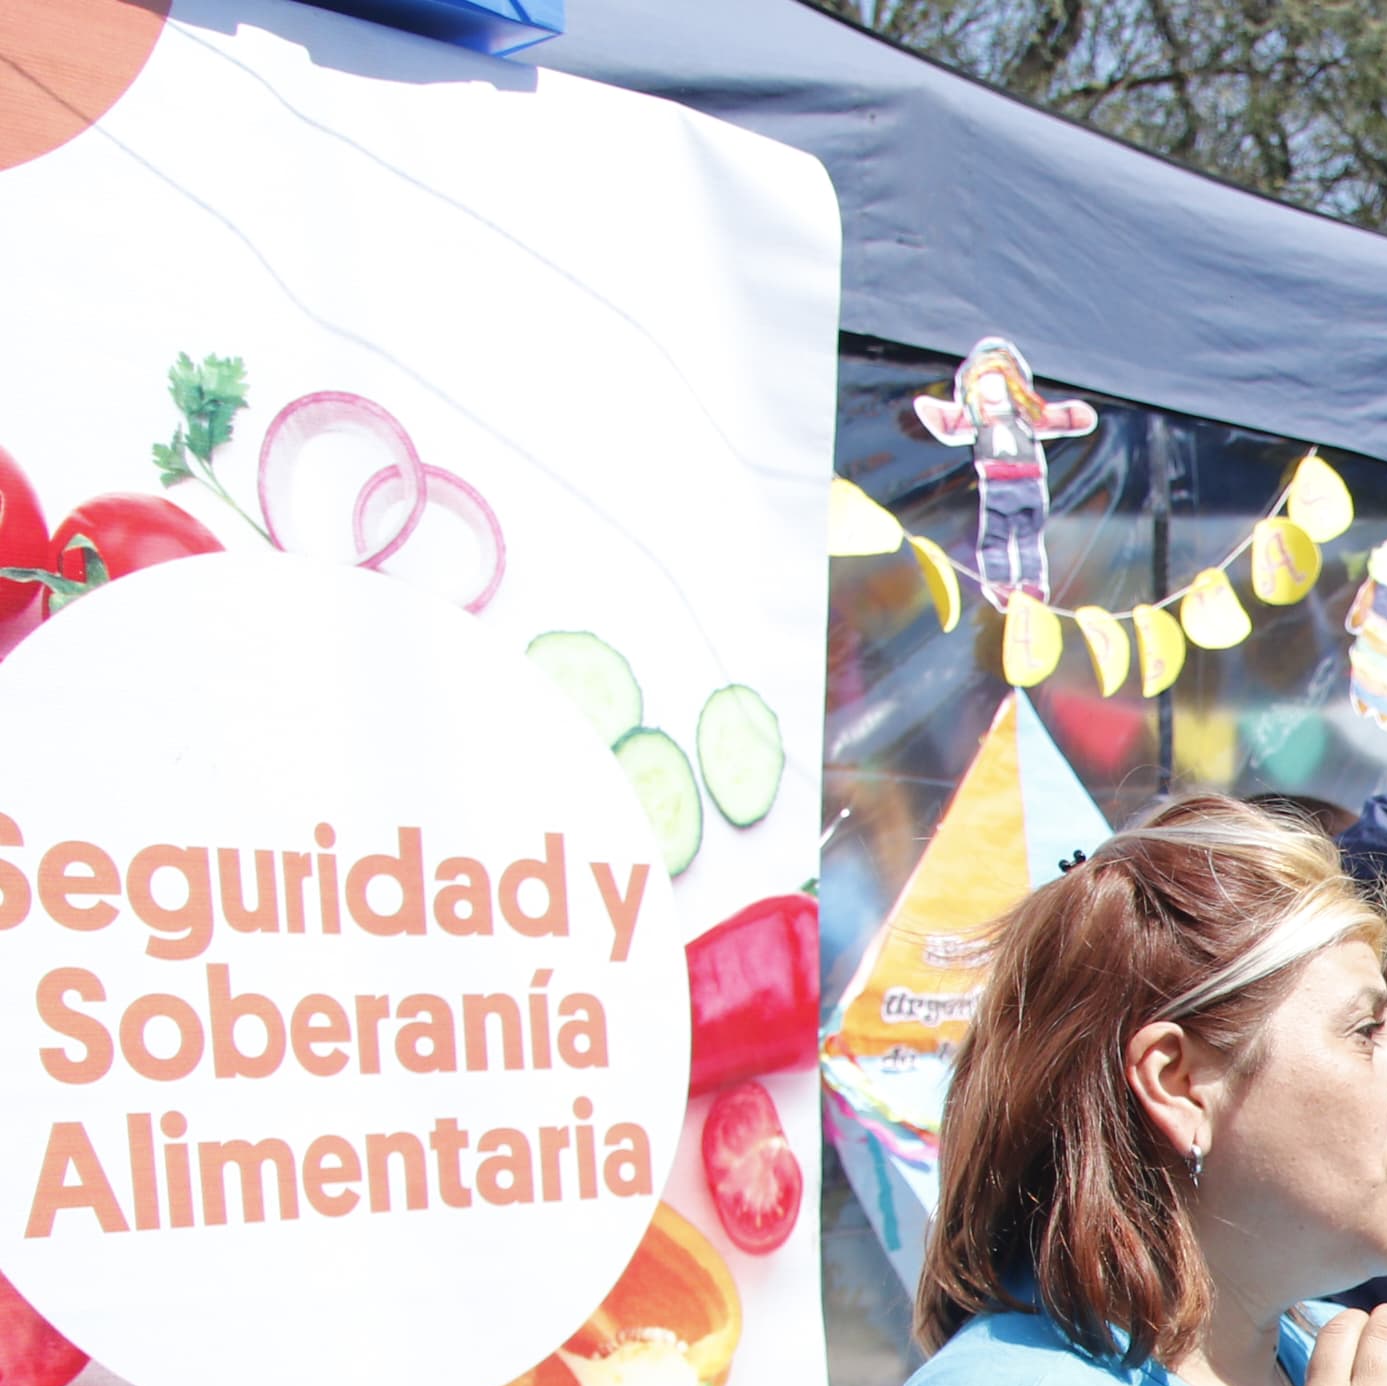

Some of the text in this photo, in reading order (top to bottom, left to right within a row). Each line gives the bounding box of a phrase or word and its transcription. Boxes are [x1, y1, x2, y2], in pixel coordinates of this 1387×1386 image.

[0, 811, 651, 963] Seguridad y
[34, 962, 609, 1084] Soberanía
[23, 1096, 654, 1239] Alimentaria
